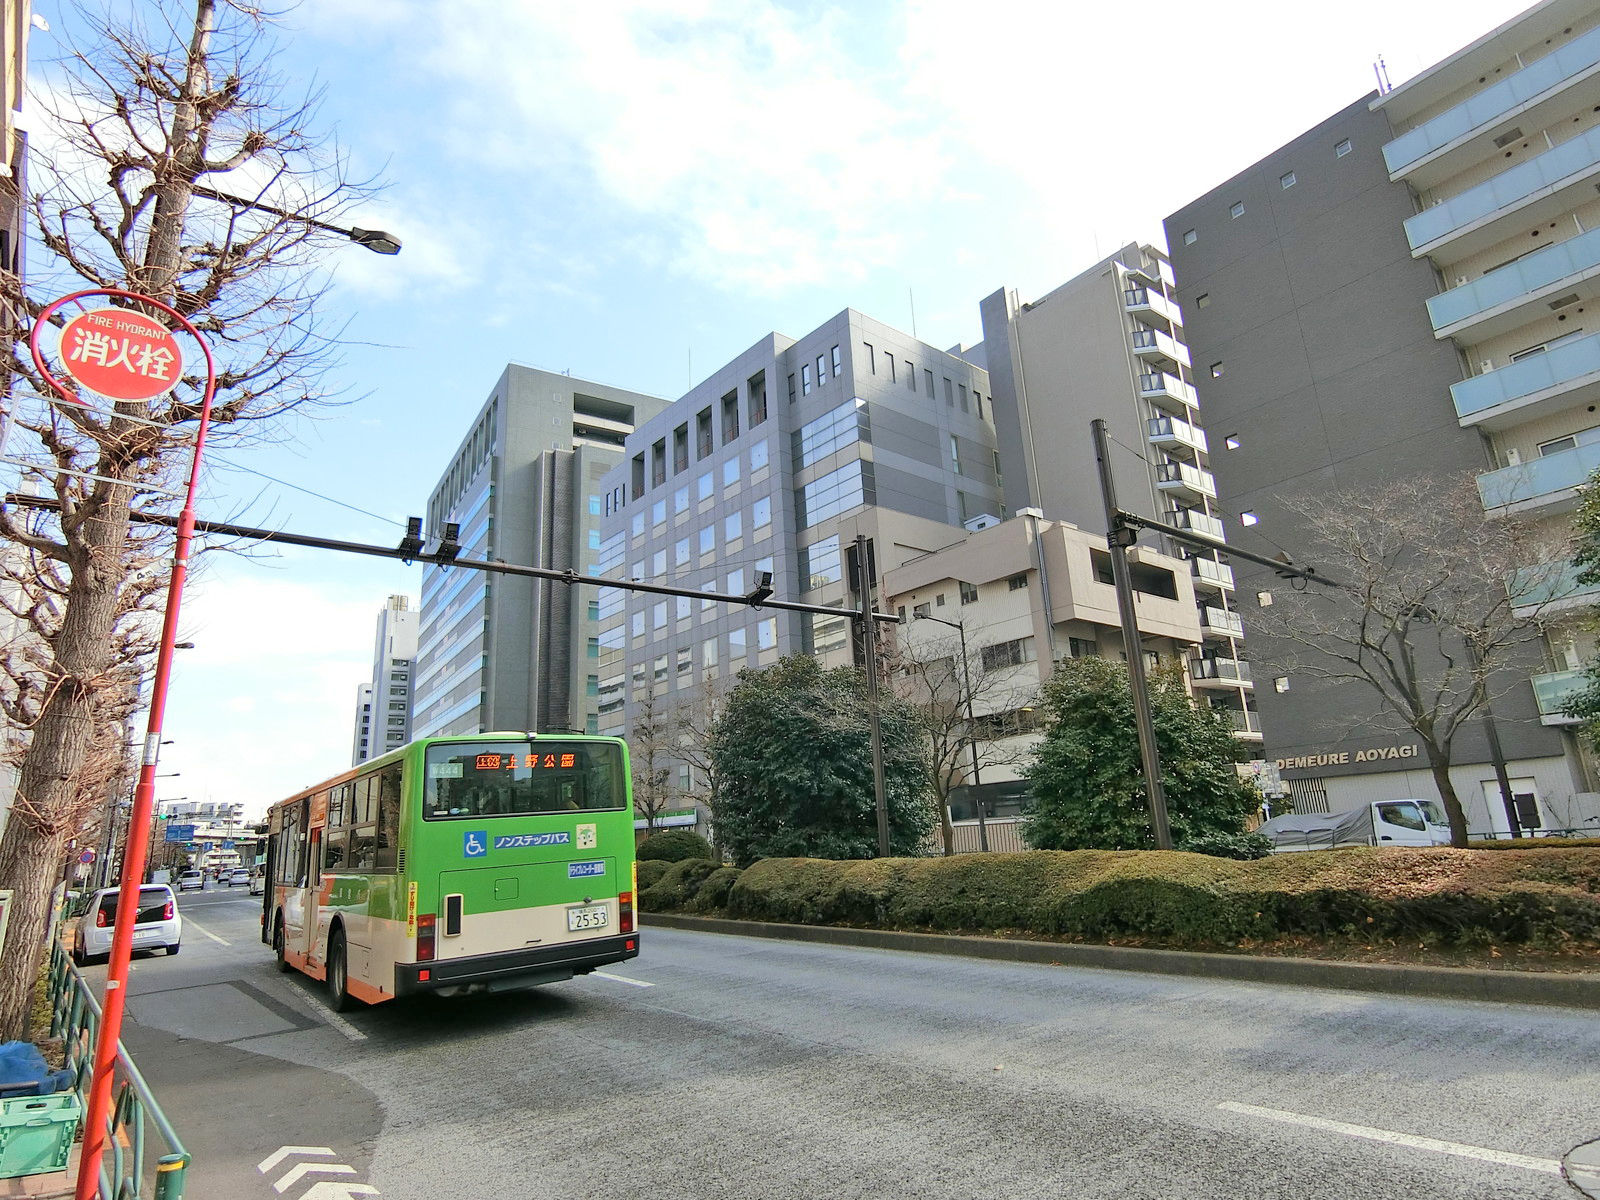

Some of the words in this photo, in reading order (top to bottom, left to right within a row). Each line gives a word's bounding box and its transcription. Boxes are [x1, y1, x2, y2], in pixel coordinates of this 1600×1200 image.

[88, 314, 113, 328] FIRE
[116, 321, 167, 340] HYDRANT
[70, 327, 175, 381] 消火栓
[506, 754, 575, 769] 上野公園
[1276, 753, 1349, 770] DEMEURE
[1355, 745, 1418, 762] AOYAGI
[495, 832, 570, 849] ノンステップバス
